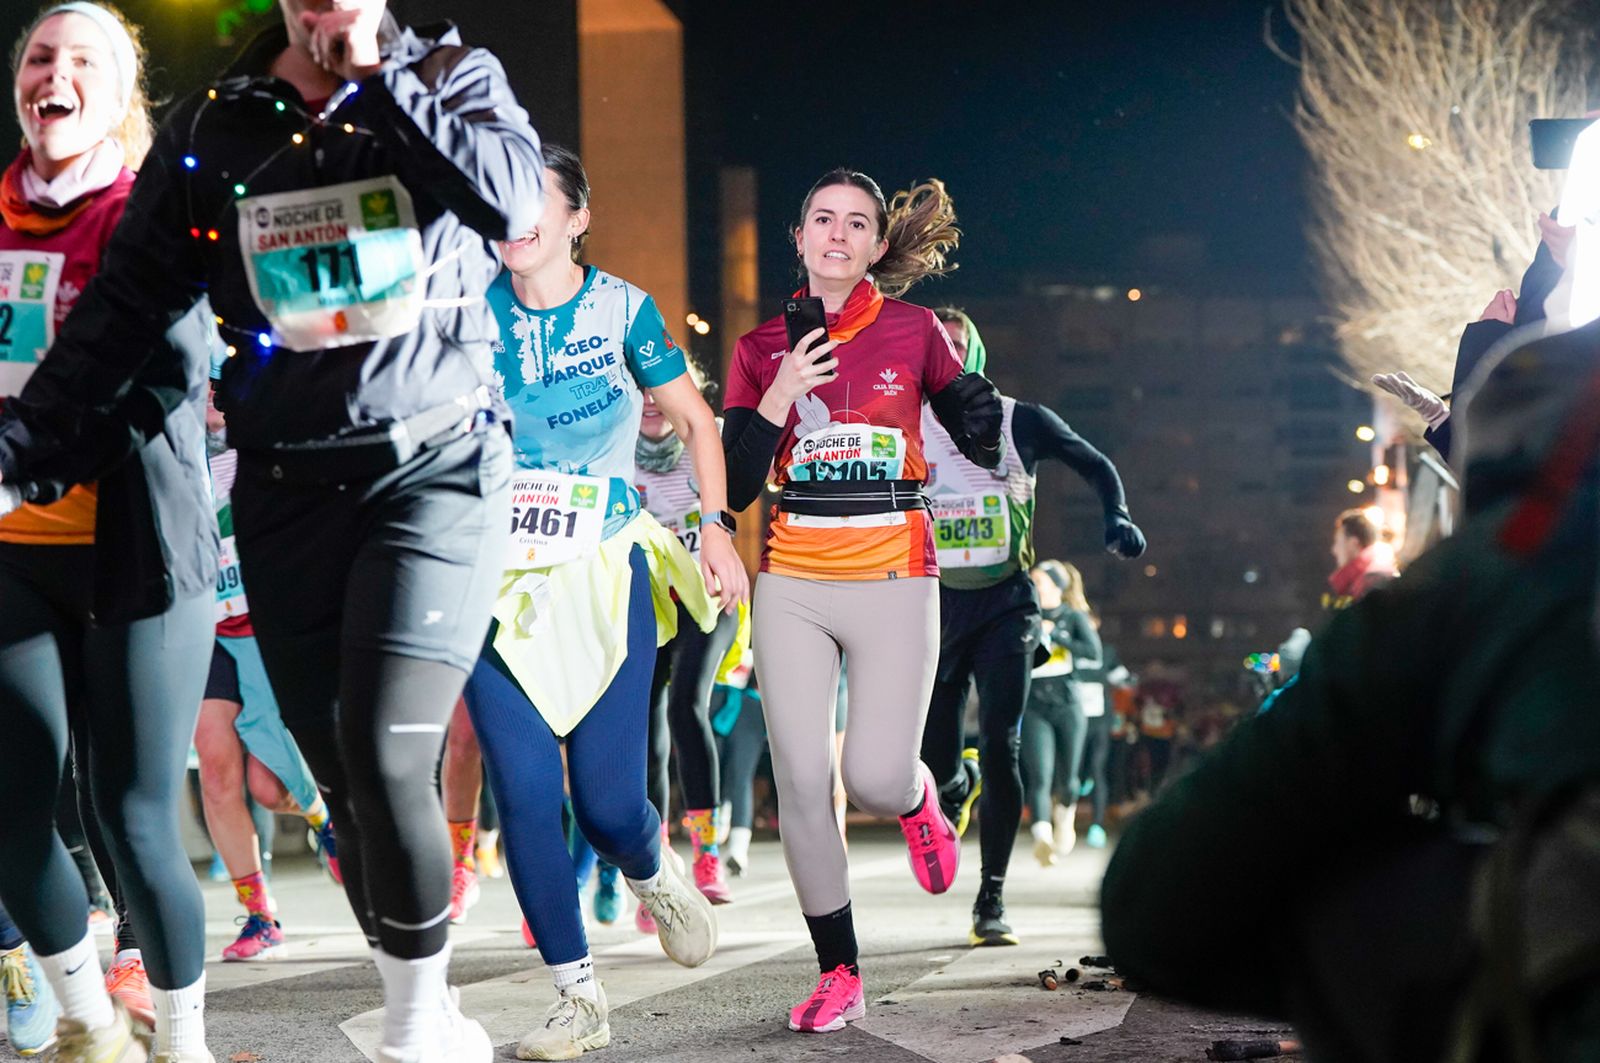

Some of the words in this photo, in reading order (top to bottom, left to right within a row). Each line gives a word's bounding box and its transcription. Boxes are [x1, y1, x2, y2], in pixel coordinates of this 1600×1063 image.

[273, 209, 320, 228] NOCHE
[325, 203, 344, 219] DE
[257, 231, 291, 250] SAN
[564, 335, 609, 357] GEO-
[541, 352, 617, 388] PARQUE
[569, 371, 618, 400] TRAIL
[546, 385, 624, 429] FONELAS
[848, 437, 861, 447] DE
[823, 448, 862, 462] ANTÓN
[940, 517, 994, 541] 5843
